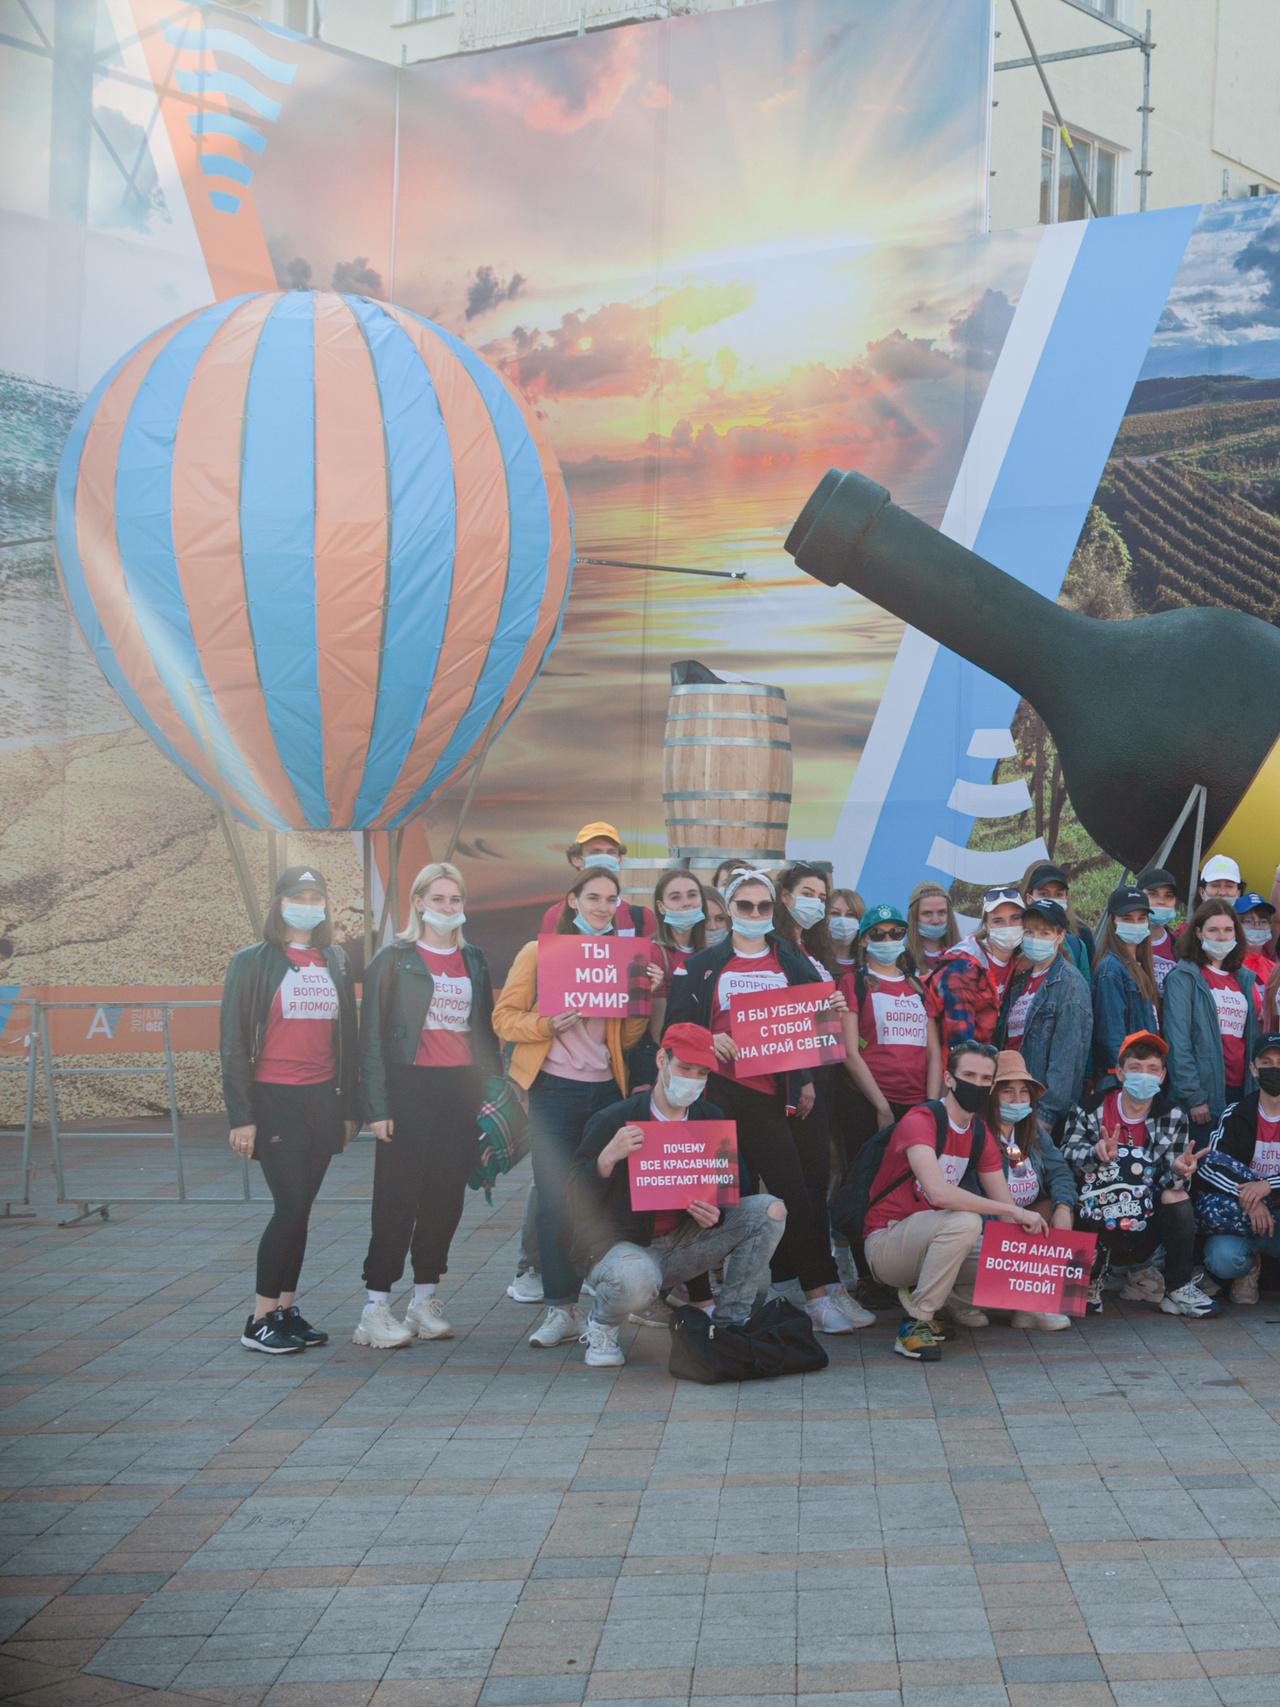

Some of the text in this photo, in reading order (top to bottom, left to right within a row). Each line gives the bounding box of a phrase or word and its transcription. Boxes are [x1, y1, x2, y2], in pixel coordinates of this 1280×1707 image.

[581, 943, 610, 959] ТЫ
[302, 974, 328, 984] ЕСТЬ
[575, 964, 617, 984] МОЙ
[293, 987, 336, 997] ВОПРОС
[435, 982, 462, 995] ЕСТЬ
[289, 1002, 339, 1012] Я ПОМОГУ
[429, 997, 470, 1011] ОПРОС?
[564, 992, 630, 1009] КУМИР
[894, 999, 919, 1009] ЕСТЬ
[1221, 995, 1241, 1006] ЕСТЬ
[737, 999, 831, 1023] Я БЫ УБЕЖАЛА
[145, 1021, 164, 1032] ФЕС
[760, 1017, 812, 1038] С ТОБОЙ
[882, 1026, 890, 1037] Я
[741, 1034, 838, 1059] НА КРАЙ СВЕТА
[663, 1143, 706, 1154] ПОЧЕМУ
[640, 1158, 729, 1171] ВСЕ КРАСАВЧИКИ
[636, 1174, 734, 1187] ПРОБЕГАЮТ МИМО?
[1001, 1240, 1073, 1260] ВСЯ АНАПА
[986, 1257, 1083, 1279] ВОСХИЩАЕТСЯ
[1008, 1278, 1056, 1295] ТОБОЙ!
